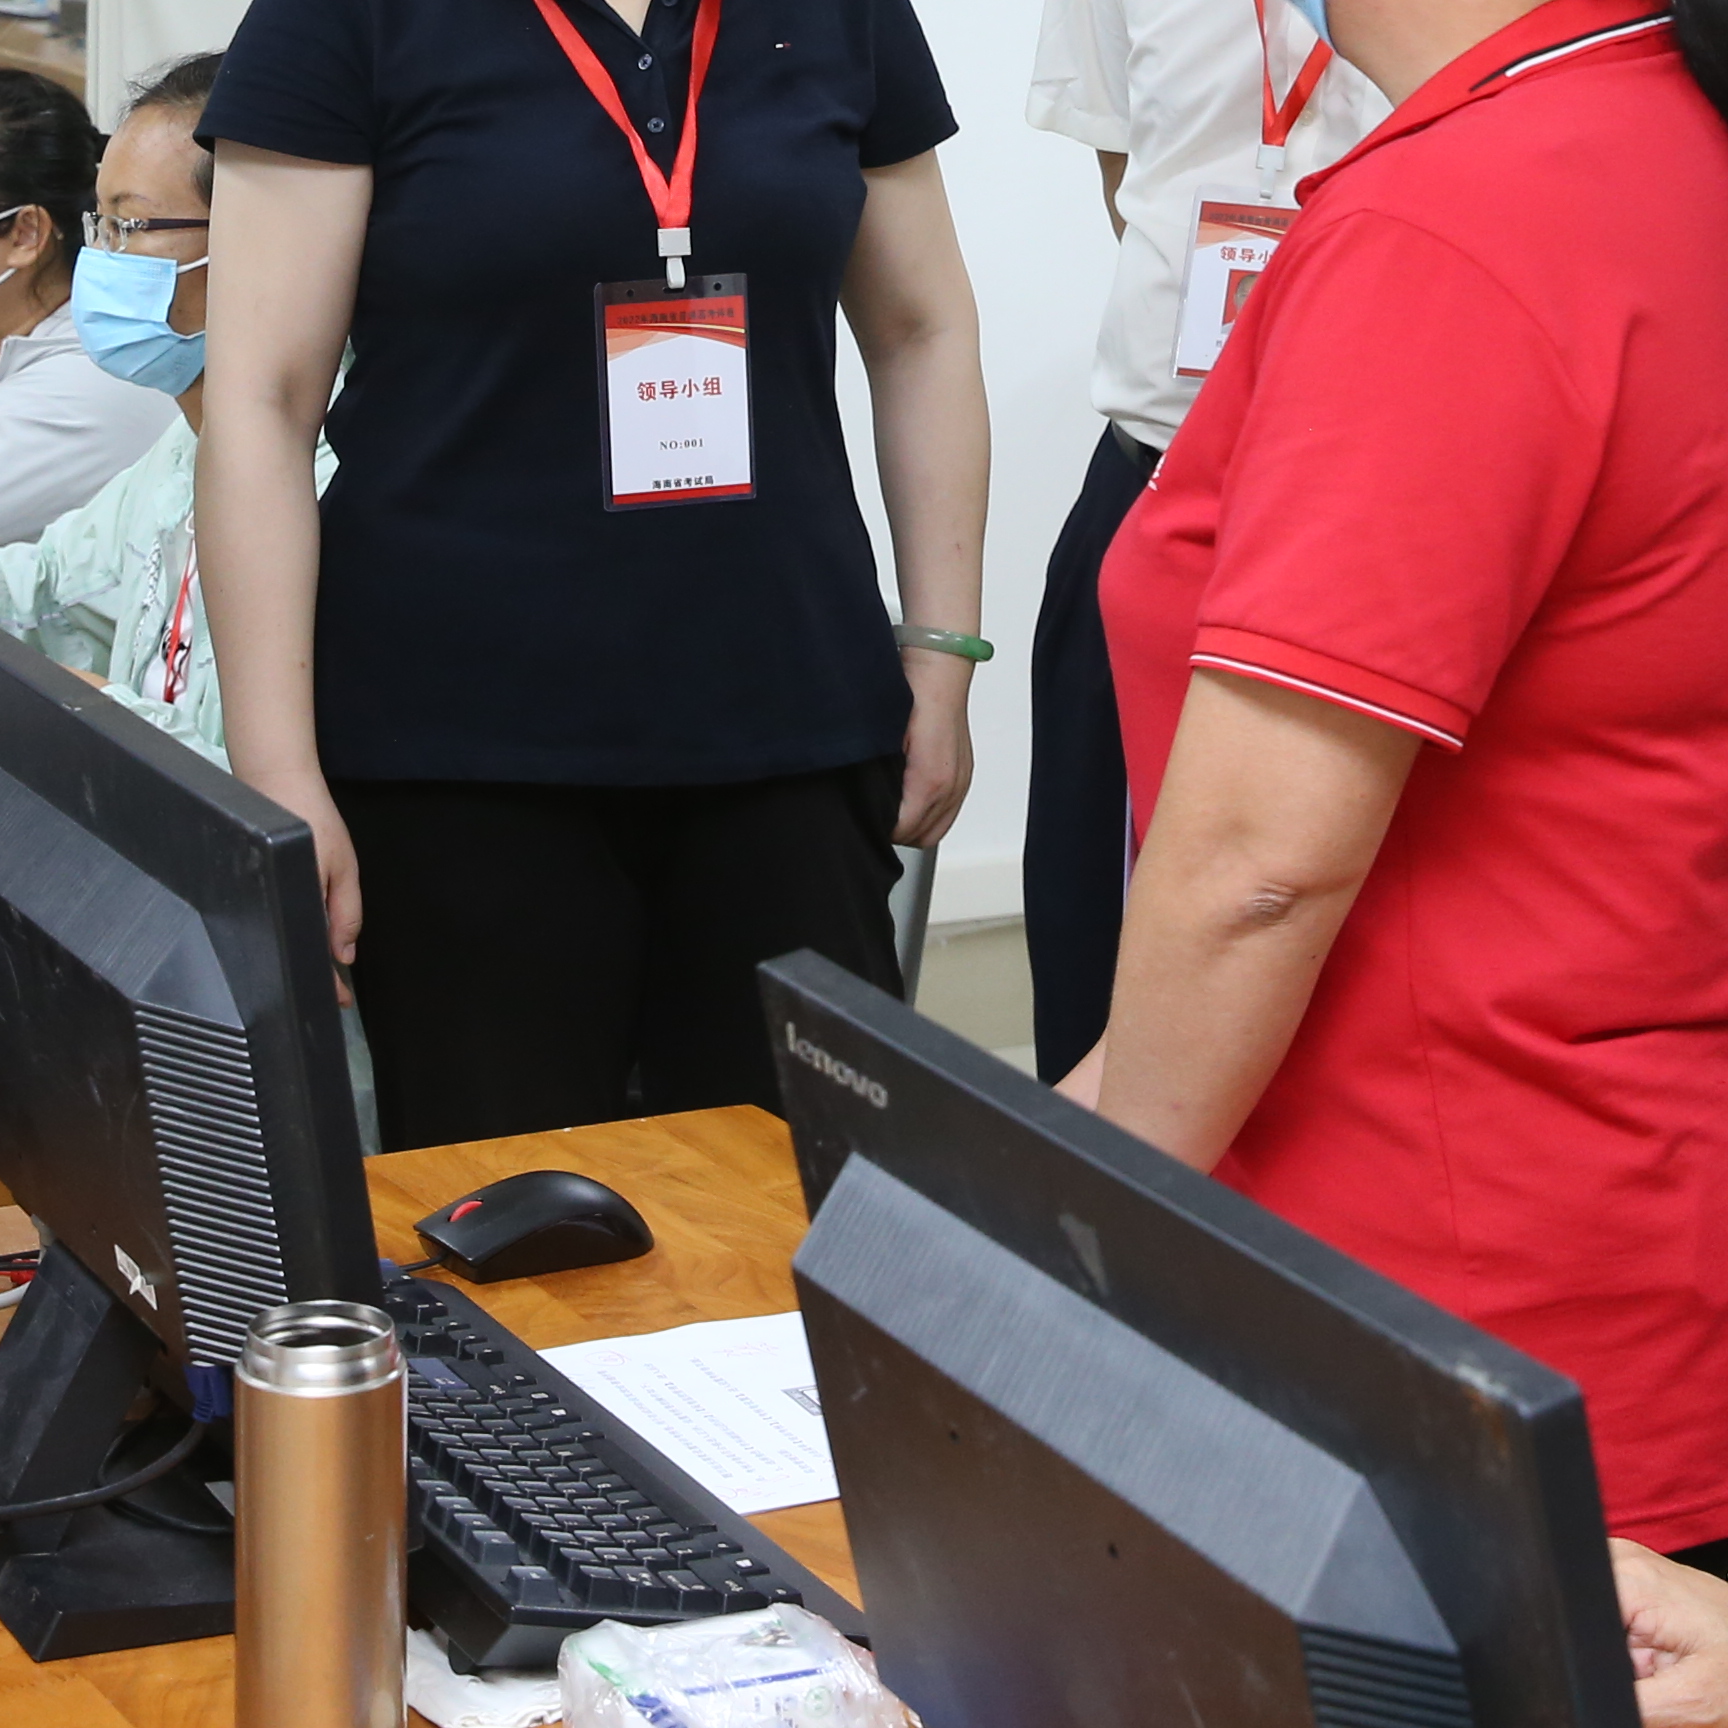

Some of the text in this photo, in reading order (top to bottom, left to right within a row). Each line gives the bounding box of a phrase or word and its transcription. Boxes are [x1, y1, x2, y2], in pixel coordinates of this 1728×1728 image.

[637, 376, 722, 402] 领导小组
[651, 475, 714, 490] 海南省考试局
[785, 1021, 888, 1110] lenovo
